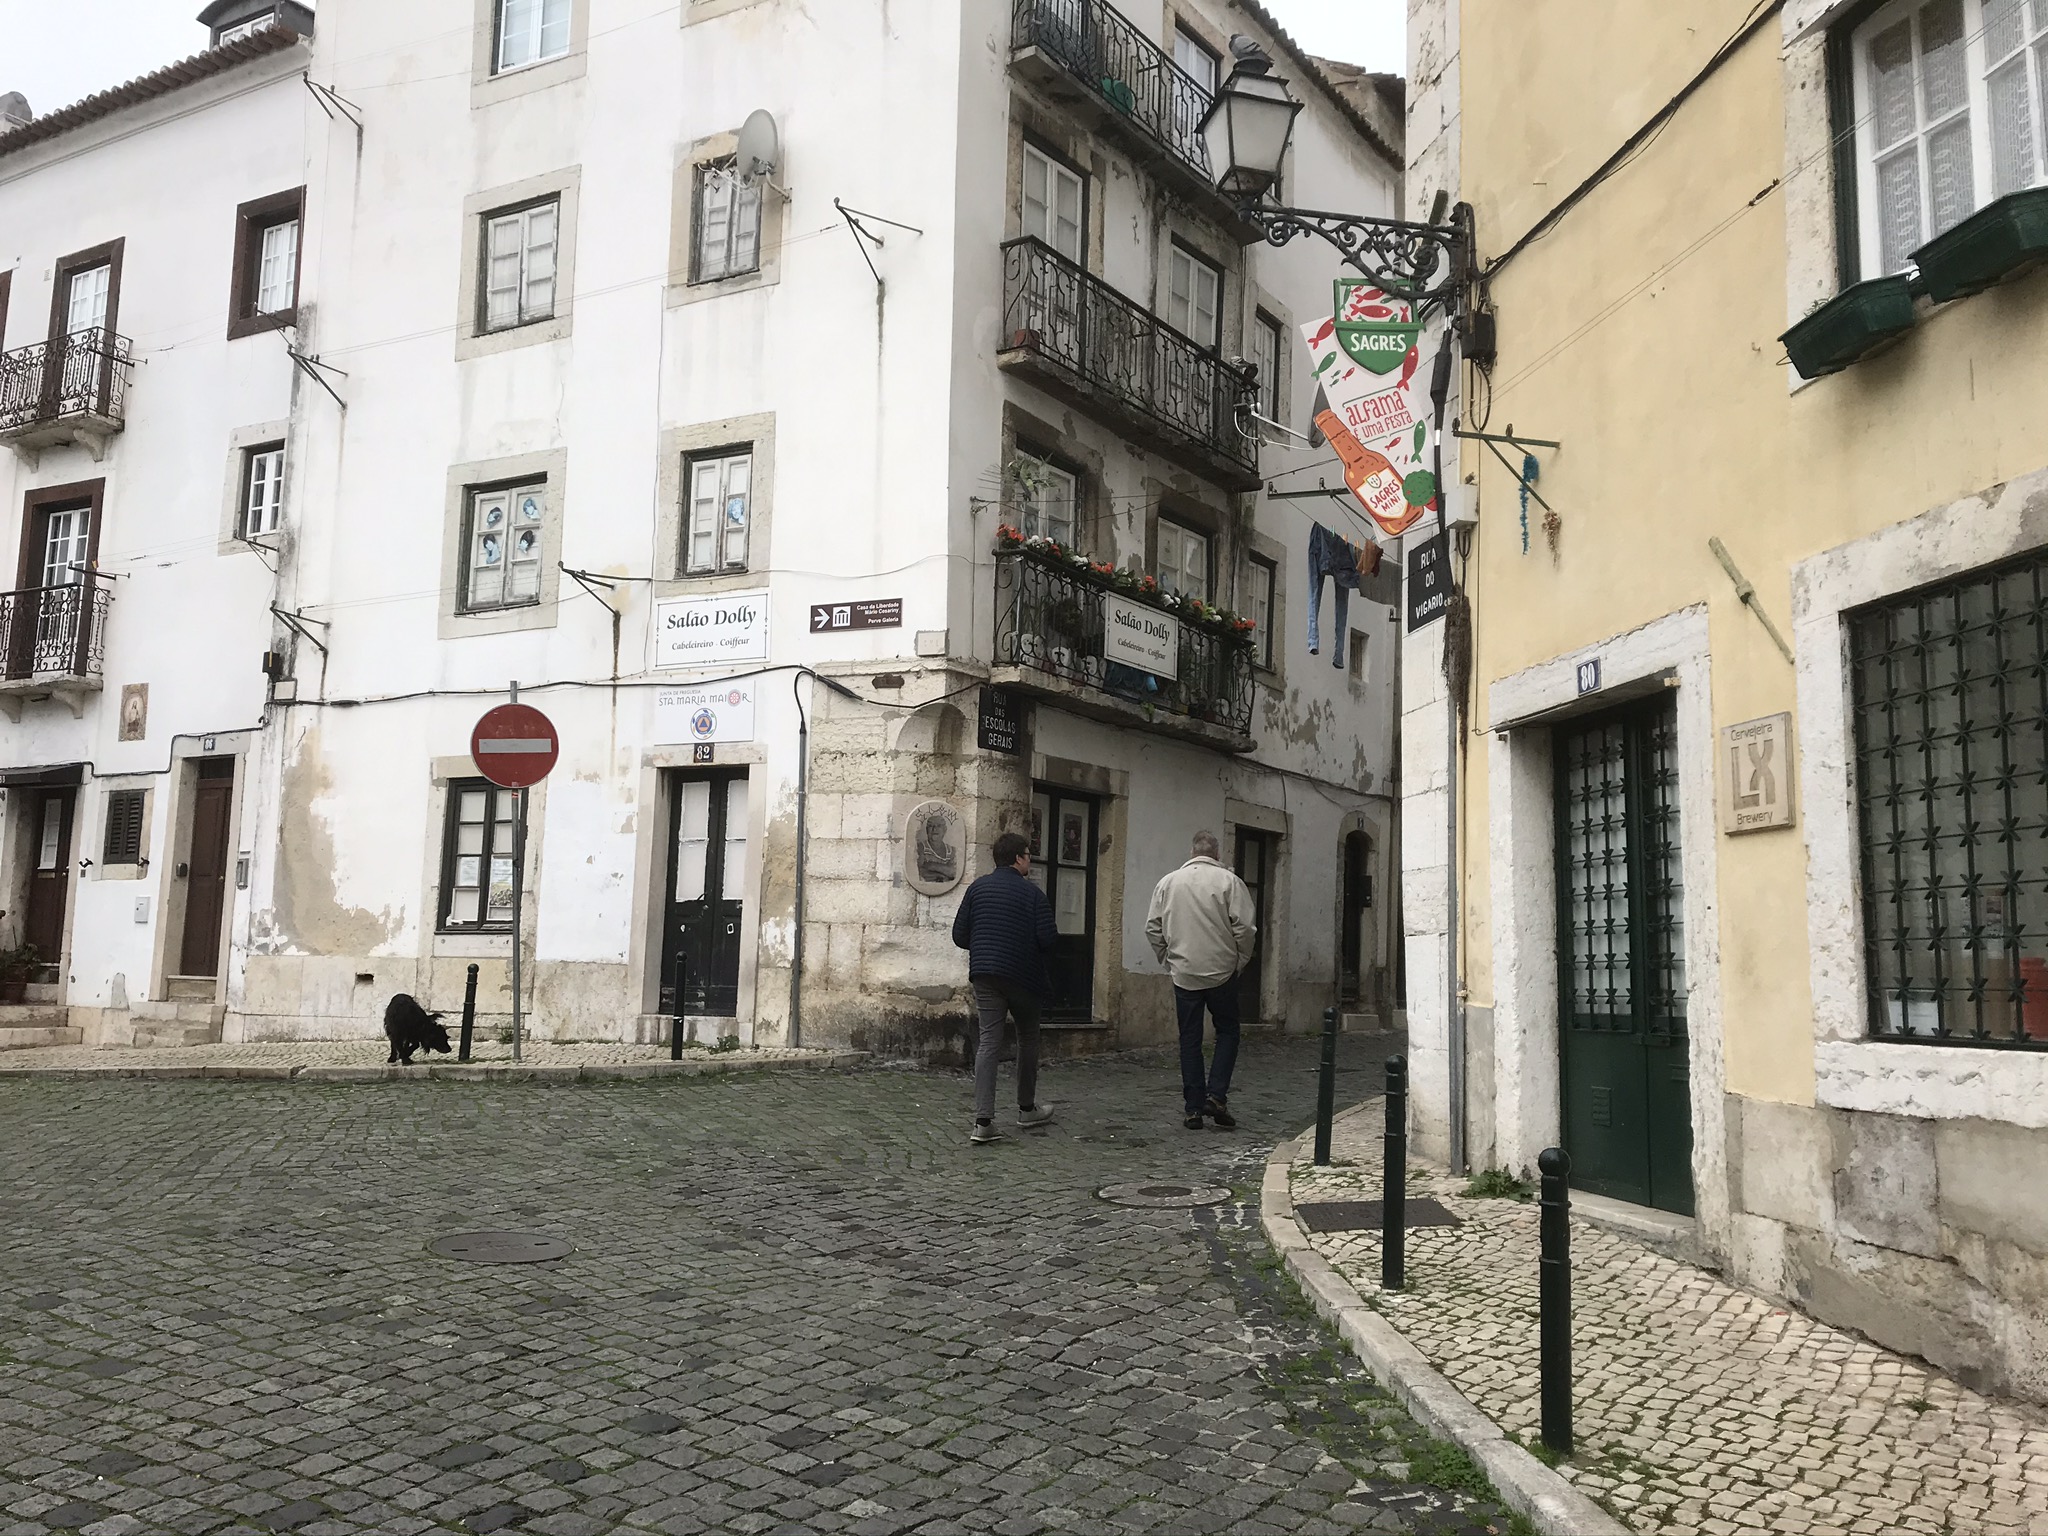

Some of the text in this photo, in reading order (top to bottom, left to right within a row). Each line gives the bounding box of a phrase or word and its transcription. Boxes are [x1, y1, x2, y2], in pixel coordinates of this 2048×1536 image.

[1351, 333, 1406, 352] SAGRES
[1370, 479, 1400, 508] SAGRES
[1421, 548, 1436, 569] RUA
[1426, 571, 1435, 587] DO
[667, 605, 756, 629] Salão Dolly
[1115, 609, 1170, 646] Salão Dolly
[672, 636, 750, 650] Cabeleireiro Coiffeur
[1581, 662, 1595, 690] 80
[677, 695, 706, 705] MARIA
[993, 691, 1007, 706] RUA
[995, 707, 1005, 717] DAS
[985, 715, 1016, 734] ESCOLAS
[1730, 723, 1773, 741] Cervejeira
[988, 732, 1013, 749] GERAIS
[697, 746, 710, 759] 82
[1737, 811, 1773, 825] Brewery
